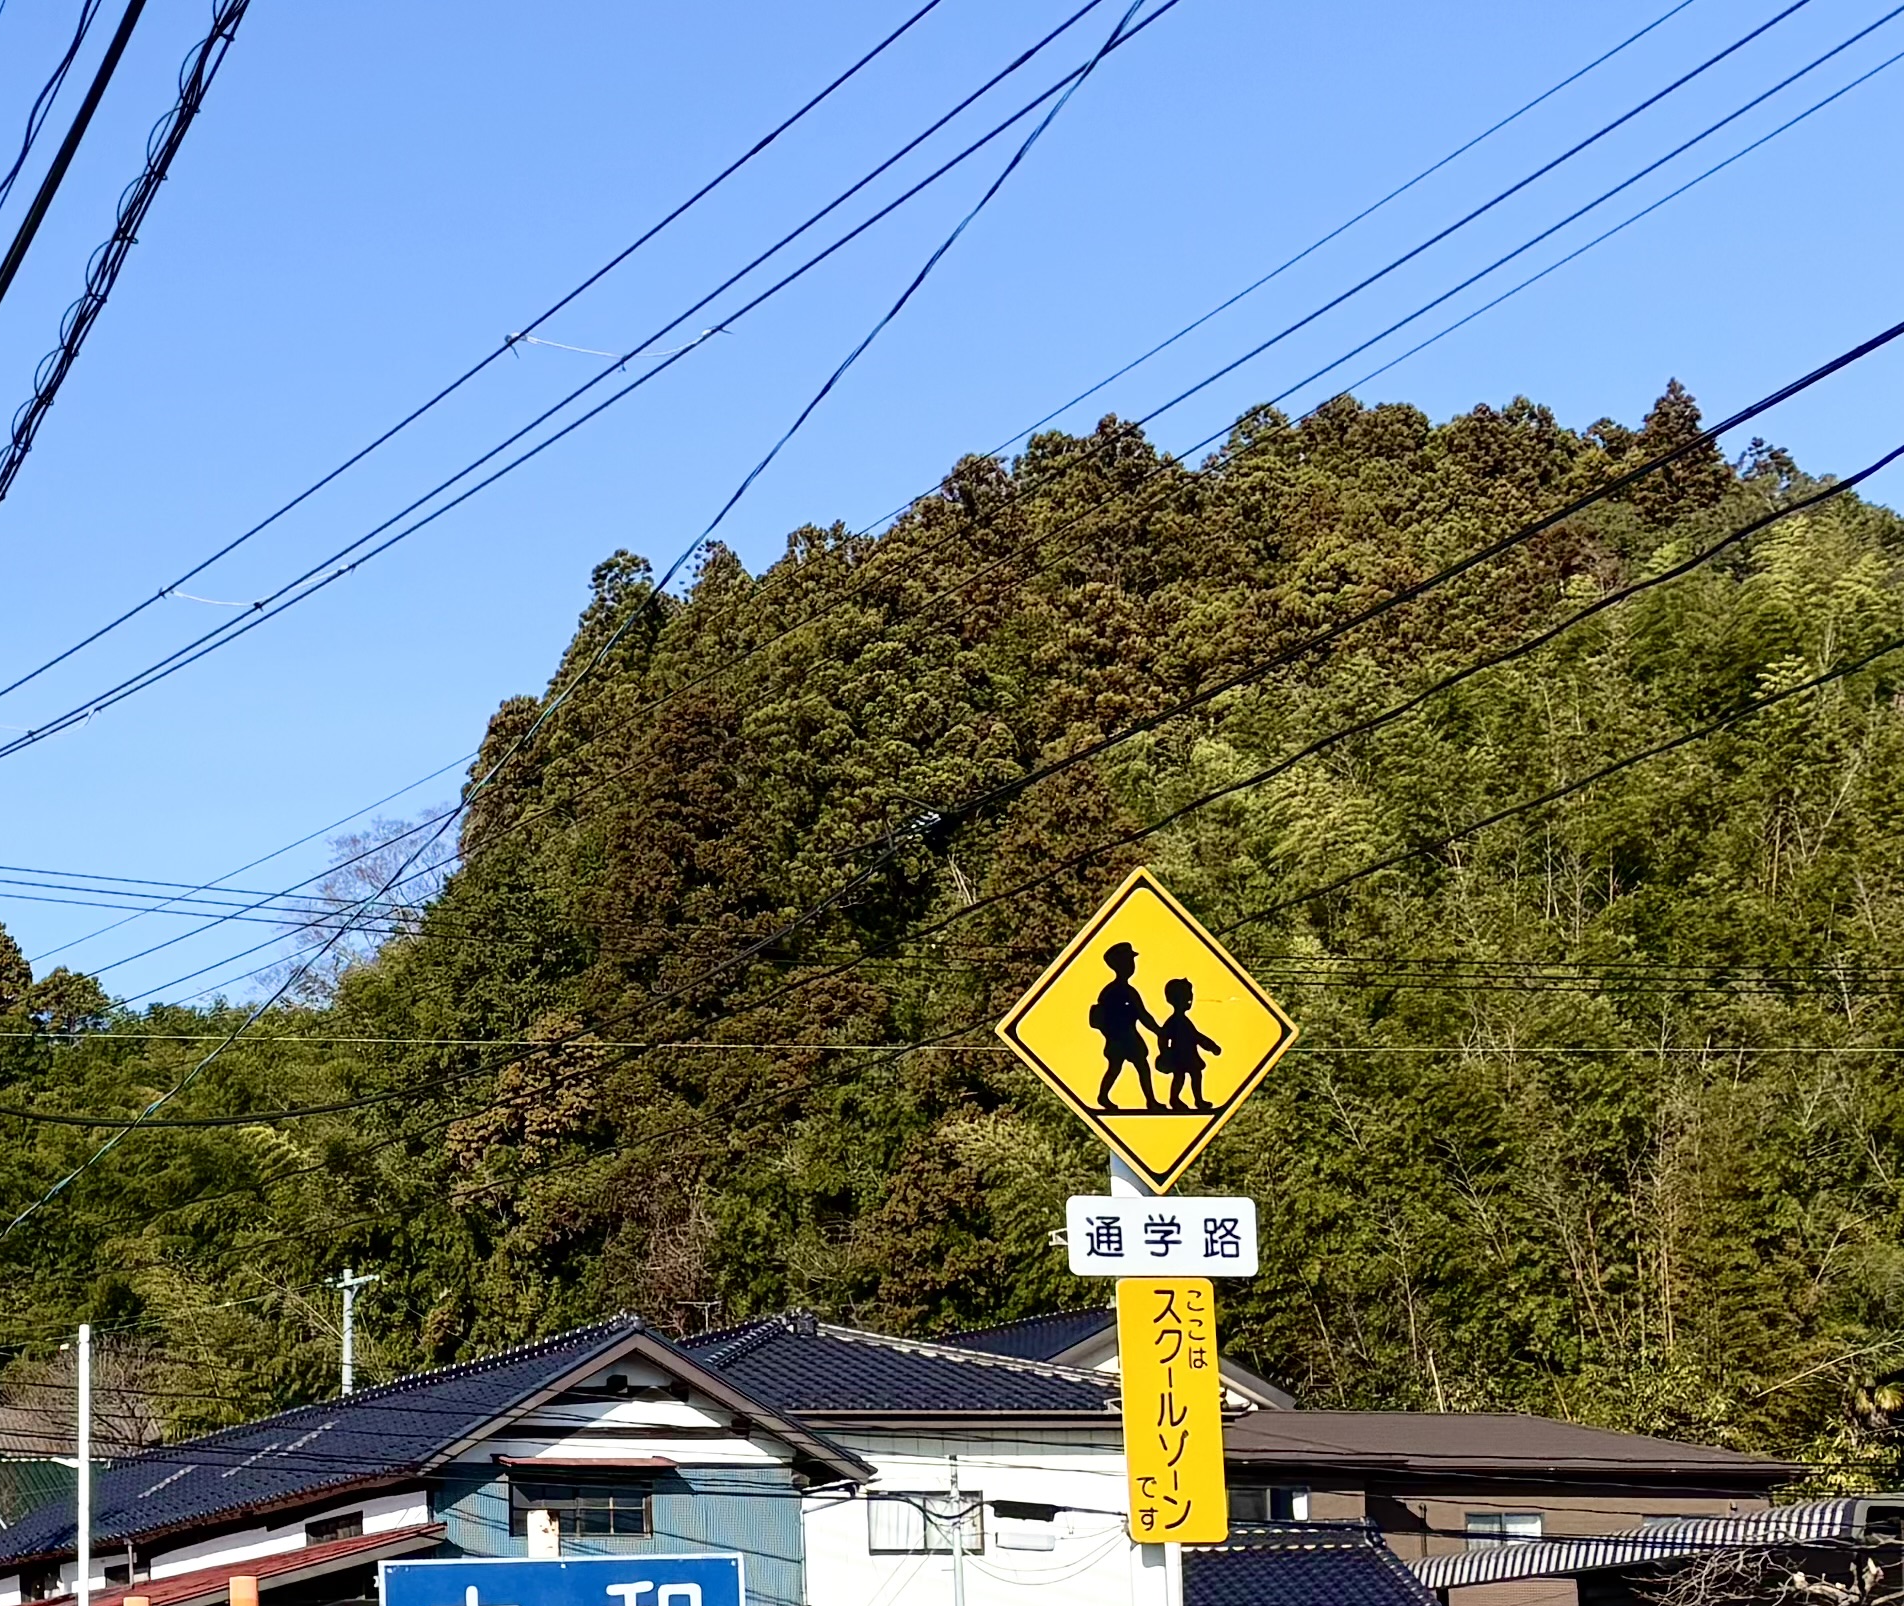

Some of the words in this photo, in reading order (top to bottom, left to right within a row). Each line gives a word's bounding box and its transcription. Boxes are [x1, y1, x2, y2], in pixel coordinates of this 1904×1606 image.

[1084, 1213, 1243, 1259] 通学路
[1186, 1289, 1209, 1370] ここは
[1152, 1289, 1193, 1531] スクールゾーン
[1136, 1476, 1160, 1532] です
